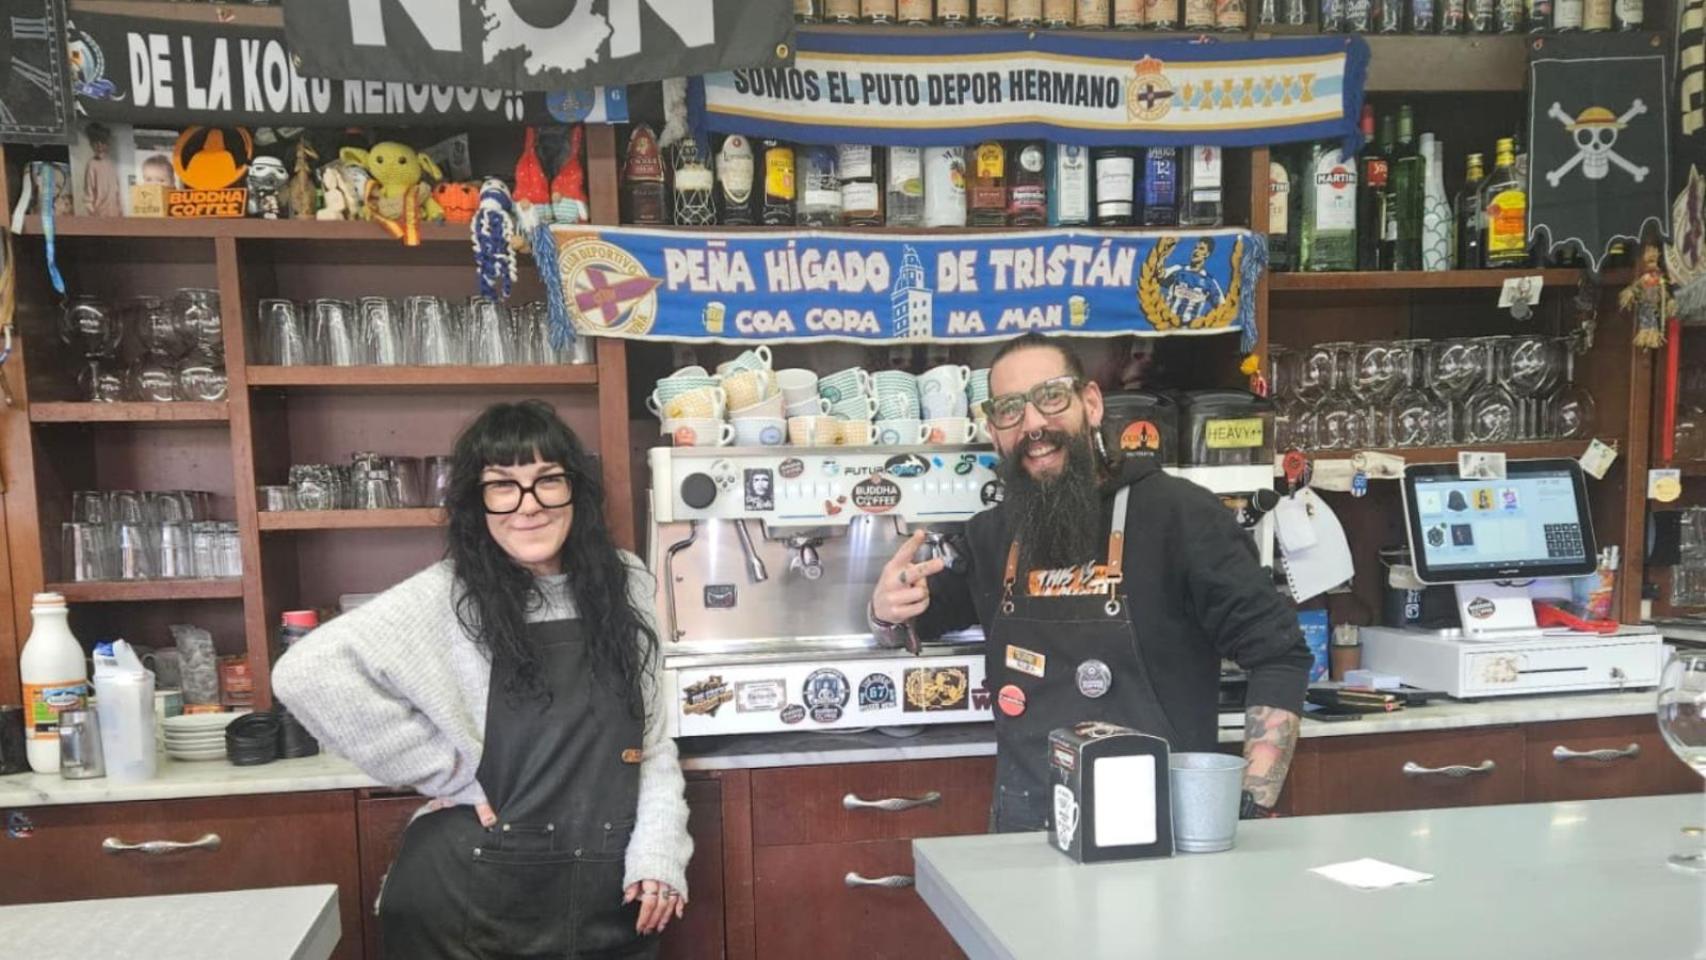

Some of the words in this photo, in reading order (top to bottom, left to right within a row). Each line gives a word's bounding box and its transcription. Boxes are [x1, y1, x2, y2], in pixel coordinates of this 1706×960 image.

[127, 32, 174, 108] DE
[181, 36, 232, 111] LA
[734, 67, 821, 102] SOMOS
[828, 71, 855, 105] EL
[862, 74, 920, 106] PUTO
[927, 72, 1002, 106] DEPOR
[1008, 69, 1120, 110] HERMANO
[169, 190, 241, 204] BUDDHA
[170, 203, 239, 216] COFFEE
[663, 240, 756, 293] PEÑA
[764, 240, 890, 293] HÍGADO
[937, 249, 979, 293] DE
[989, 238, 1138, 291] TRISTÁN
[735, 309, 796, 334] COA
[805, 307, 881, 334] COPA
[947, 309, 985, 334] NA
[997, 305, 1064, 331] MAN
[856, 485, 898, 496] BUDDHA
[857, 496, 897, 506] COFFEE
[1037, 564, 1077, 587] THIS
[1080, 560, 1097, 585] IS
